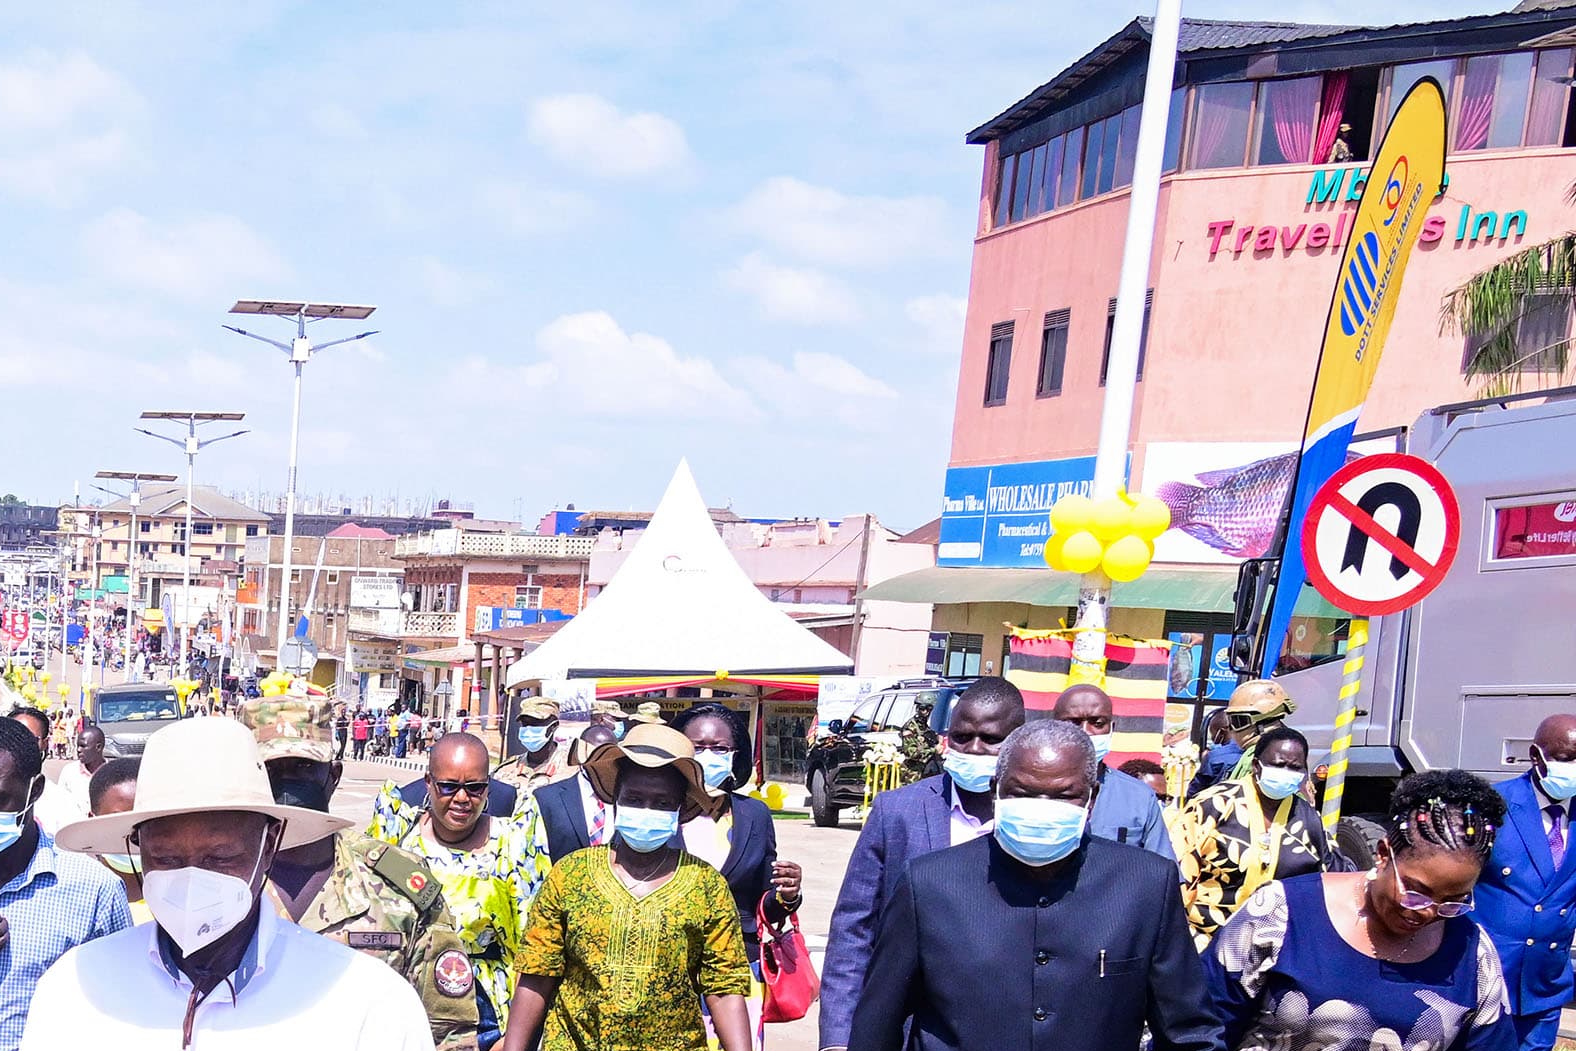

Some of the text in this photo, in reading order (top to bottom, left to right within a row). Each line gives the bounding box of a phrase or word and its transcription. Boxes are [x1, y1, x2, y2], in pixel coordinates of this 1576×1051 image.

[1456, 205, 1527, 240] Inn
[1355, 182, 1423, 362] DOTT SERVICES LIMITED
[989, 483, 1054, 512] WHOLESALE
[362, 934, 388, 945] SFC
